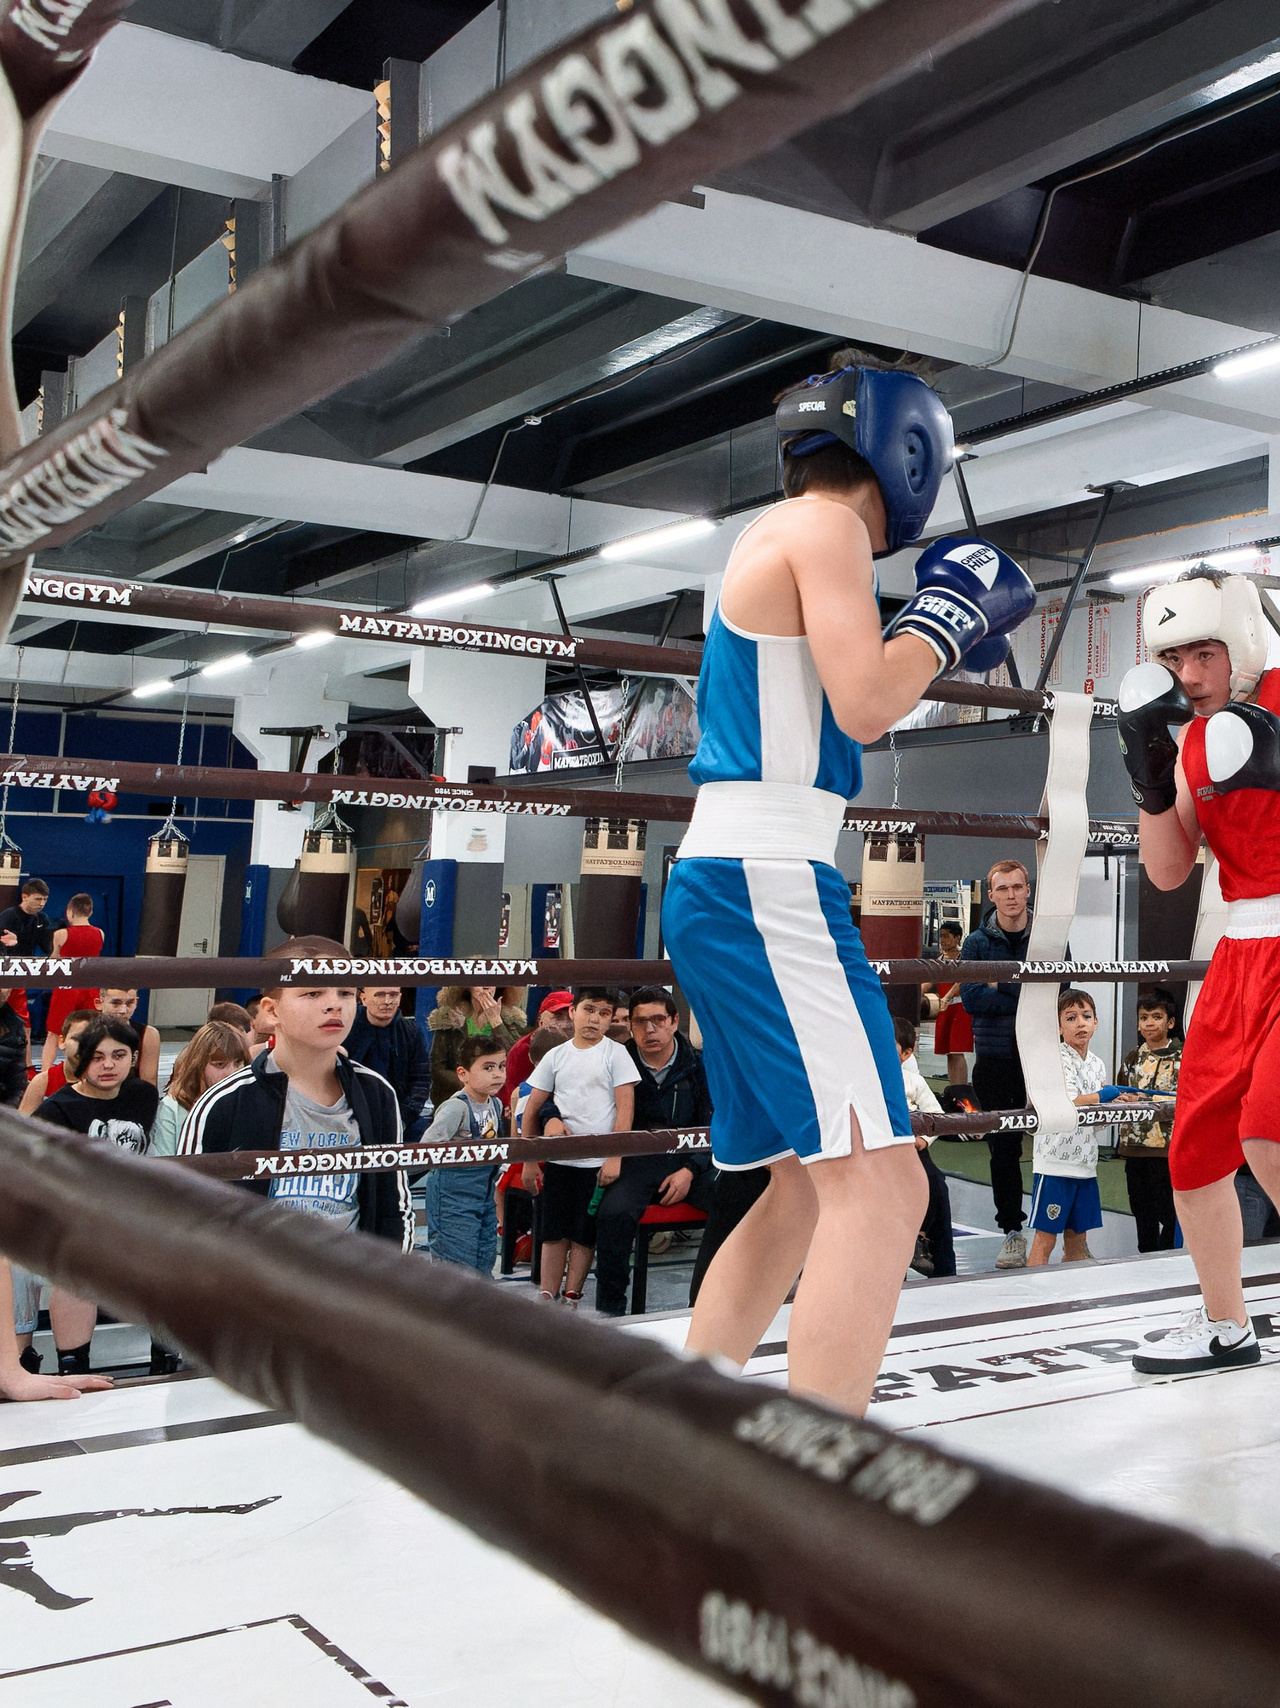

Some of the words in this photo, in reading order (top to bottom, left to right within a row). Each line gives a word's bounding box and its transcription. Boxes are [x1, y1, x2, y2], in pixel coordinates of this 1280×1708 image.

[798, 400, 826, 413] SPECIAL
[960, 546, 991, 566] GREEN
[968, 554, 997, 571] HILL
[22, 577, 132, 605] NGGYM
[914, 601, 962, 632] HILL
[918, 594, 976, 630] GREEN
[338, 614, 577, 657] MAYFATBOXINGGYM
[0, 771, 120, 793] MAYFAT
[452, 788, 474, 796] SINCE
[328, 789, 572, 817] MAYFATBOXINGGYM
[842, 819, 917, 834] MAYFAT
[290, 958, 538, 976] MAYFATBOXINGGYM
[1018, 961, 1170, 973] MAYFATBOXINGGYM
[280, 1131, 301, 1147] EW
[308, 1132, 350, 1148] YORK
[254, 1143, 510, 1175] MAYFATBOXINGGYM
